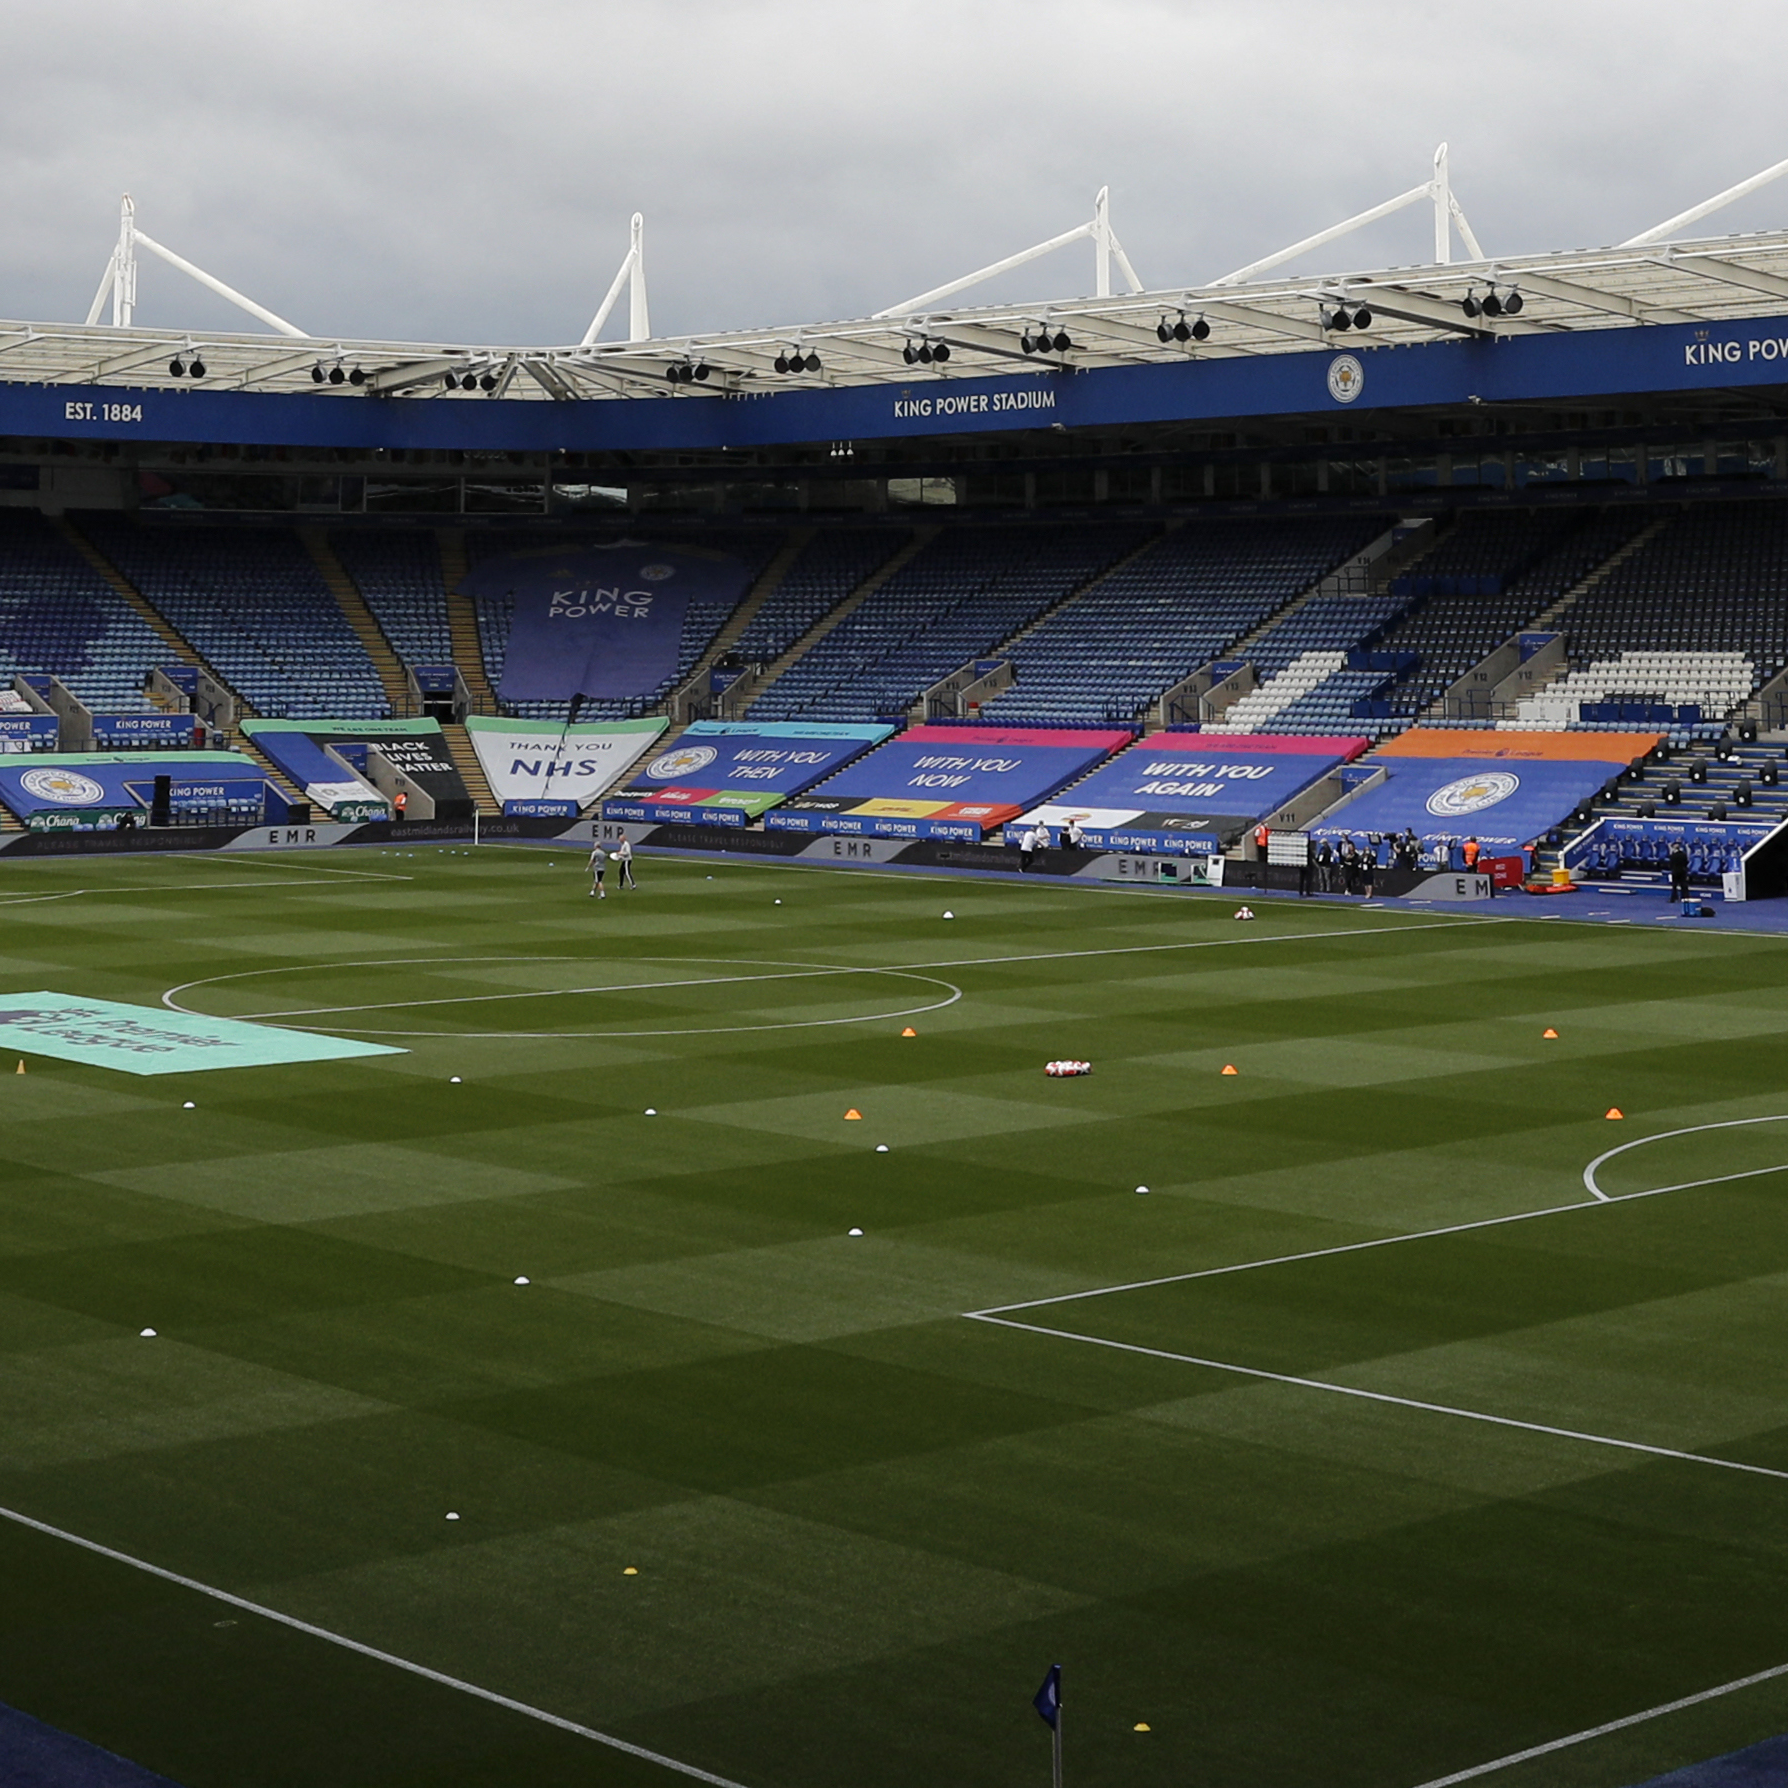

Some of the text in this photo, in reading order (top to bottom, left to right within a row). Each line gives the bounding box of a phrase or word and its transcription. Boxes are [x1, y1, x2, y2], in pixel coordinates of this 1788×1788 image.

[1685, 341, 1742, 365] KING
[894, 391, 1055, 418] KING POWER STADIUM
[65, 402, 142, 422] EST. 1884
[551, 587, 654, 607] KING
[549, 603, 649, 618] POWER
[1473, 672, 1487, 681] V12
[1518, 670, 1532, 680] V12
[116, 719, 172, 730] KING POWER
[373, 742, 430, 753] BLACK
[509, 741, 613, 751] THANK YOU
[382, 751, 433, 762] LIVES
[732, 749, 832, 764] WITH YOU
[510, 759, 597, 777] NHS
[913, 756, 1021, 773] WITH YOU
[728, 766, 786, 780] THEN
[1142, 762, 1274, 780] WITH YOU
[908, 773, 971, 788] NOW
[1134, 781, 1225, 798] AGAIN
[512, 804, 568, 814] KING POWER
[606, 807, 645, 817] KING POWER
[655, 809, 691, 820] KING POWER
[702, 811, 739, 822] KING POWER
[770, 816, 809, 827] KING POWER
[1279, 814, 1295, 822] V11
[821, 819, 862, 829] KING POWER
[875, 823, 916, 834] KING POWER
[270, 829, 315, 843] EMR
[930, 825, 973, 837] KING POWER
[1109, 835, 1157, 847] KING POWER
[1163, 838, 1212, 850] KING POWER
[834, 842, 872, 857] EMR
[1457, 878, 1488, 896] EM
